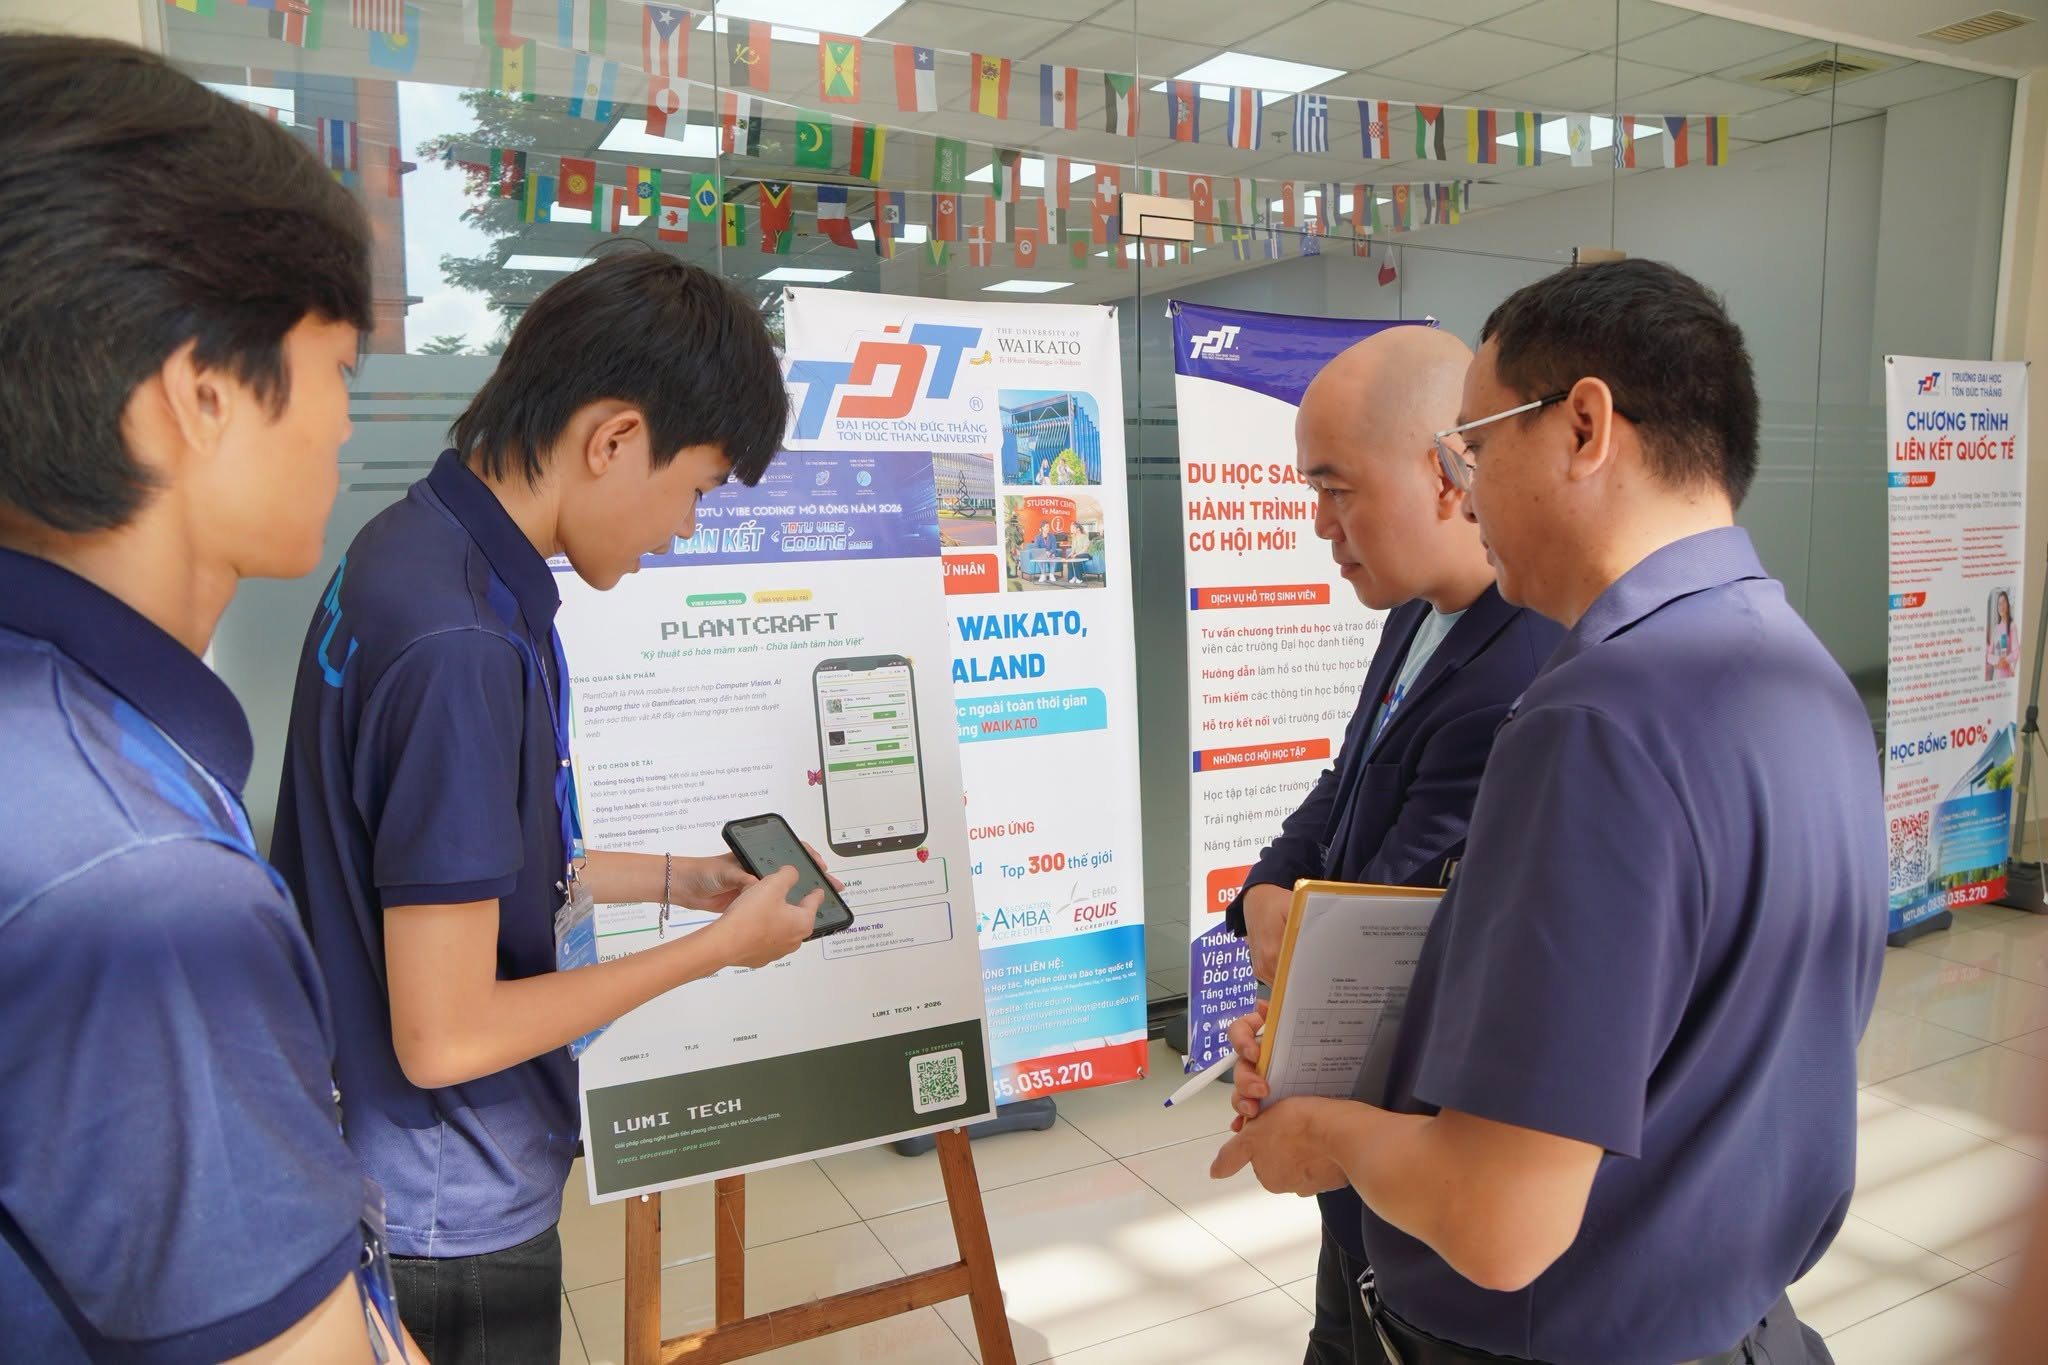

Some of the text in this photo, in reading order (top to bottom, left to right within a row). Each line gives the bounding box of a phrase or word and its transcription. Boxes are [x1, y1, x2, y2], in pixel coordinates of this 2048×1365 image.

[998, 339, 1081, 355] WAIKATO
[836, 420, 987, 434] ĐẠI HỌC TÔN ĐỨC THẮNG
[1907, 408, 2008, 431] CHƯƠNG TRÌNH
[838, 432, 988, 444] TON DUC THANG UNIVERSITY
[1896, 434, 2016, 461] LIÊN KẾT QUỐC TẾ
[1187, 462, 1216, 484] DU
[1222, 463, 1263, 491] HỌC
[726, 506, 750, 517] VIBE
[800, 503, 817, 515] MỞ
[819, 503, 848, 516] RỘNG
[851, 503, 876, 514] NĂM
[879, 504, 902, 513] 2026
[1027, 499, 1059, 507] STUDENT
[1188, 494, 1307, 521] HÀNH TRÌNH
[722, 520, 766, 552] KẾT
[816, 521, 845, 532] VIBE
[781, 535, 847, 552] CODING
[1189, 527, 1296, 557] CƠ HỘI MỚI!
[953, 562, 985, 576] NHÂN
[1211, 589, 1316, 605] DỊCH VỤ HỖ TRỢ SINH VIÊN
[661, 613, 838, 641] PLANTCRAFT
[957, 610, 1088, 642] WAIKATO,
[1202, 619, 1378, 638] Tư vấn chương trình du học và trao đổi
[1202, 636, 1364, 654] viên các trường Đại học danh tiếng
[952, 653, 1045, 684] ALAND
[715, 681, 748, 691] Computer
[750, 679, 772, 687] Vision,
[1203, 681, 1355, 705] Tìm kiếm các thông tin học bổng
[969, 695, 1087, 718] ngoài toàn thời gian
[981, 717, 1038, 733] WAIKATO
[1203, 708, 1351, 731] Hỗ trợ kết nối với trường đối tác
[1213, 746, 1306, 765] NHỮNG CƠ HỘI HỌC TẬP
[1890, 741, 1915, 763] HỌC
[1918, 732, 1948, 755] BỔNG
[1204, 779, 1310, 802] Học tập tại các trường
[970, 821, 1035, 840] CUNG ỨNG
[1000, 850, 1113, 878] Top 300 thế giới
[1092, 885, 1117, 898] EFMD
[992, 907, 1051, 932] AMBA
[1073, 902, 1117, 922] EQUIS
[858, 925, 871, 933] MỤC
[992, 925, 1052, 941] ACCREDITED
[1075, 919, 1119, 932] ACCREDITED
[1007, 965, 1022, 975] TIN
[1024, 961, 1045, 973] LIÊN
[1048, 958, 1064, 970] HỆ:
[1202, 951, 1232, 968] Viện
[1203, 965, 1253, 985] Đào tạo
[872, 1001, 942, 1018] LUMI TECH 2026
[988, 996, 1072, 1017] Website: tdtu.edu.vn
[732, 1034, 758, 1043] FIREBASE
[620, 1054, 639, 1062] GEMINI
[613, 1098, 742, 1134] LUMI TECH
[617, 1140, 721, 1165] VERCEL DEPLOYMENT OPEN SOURCE
